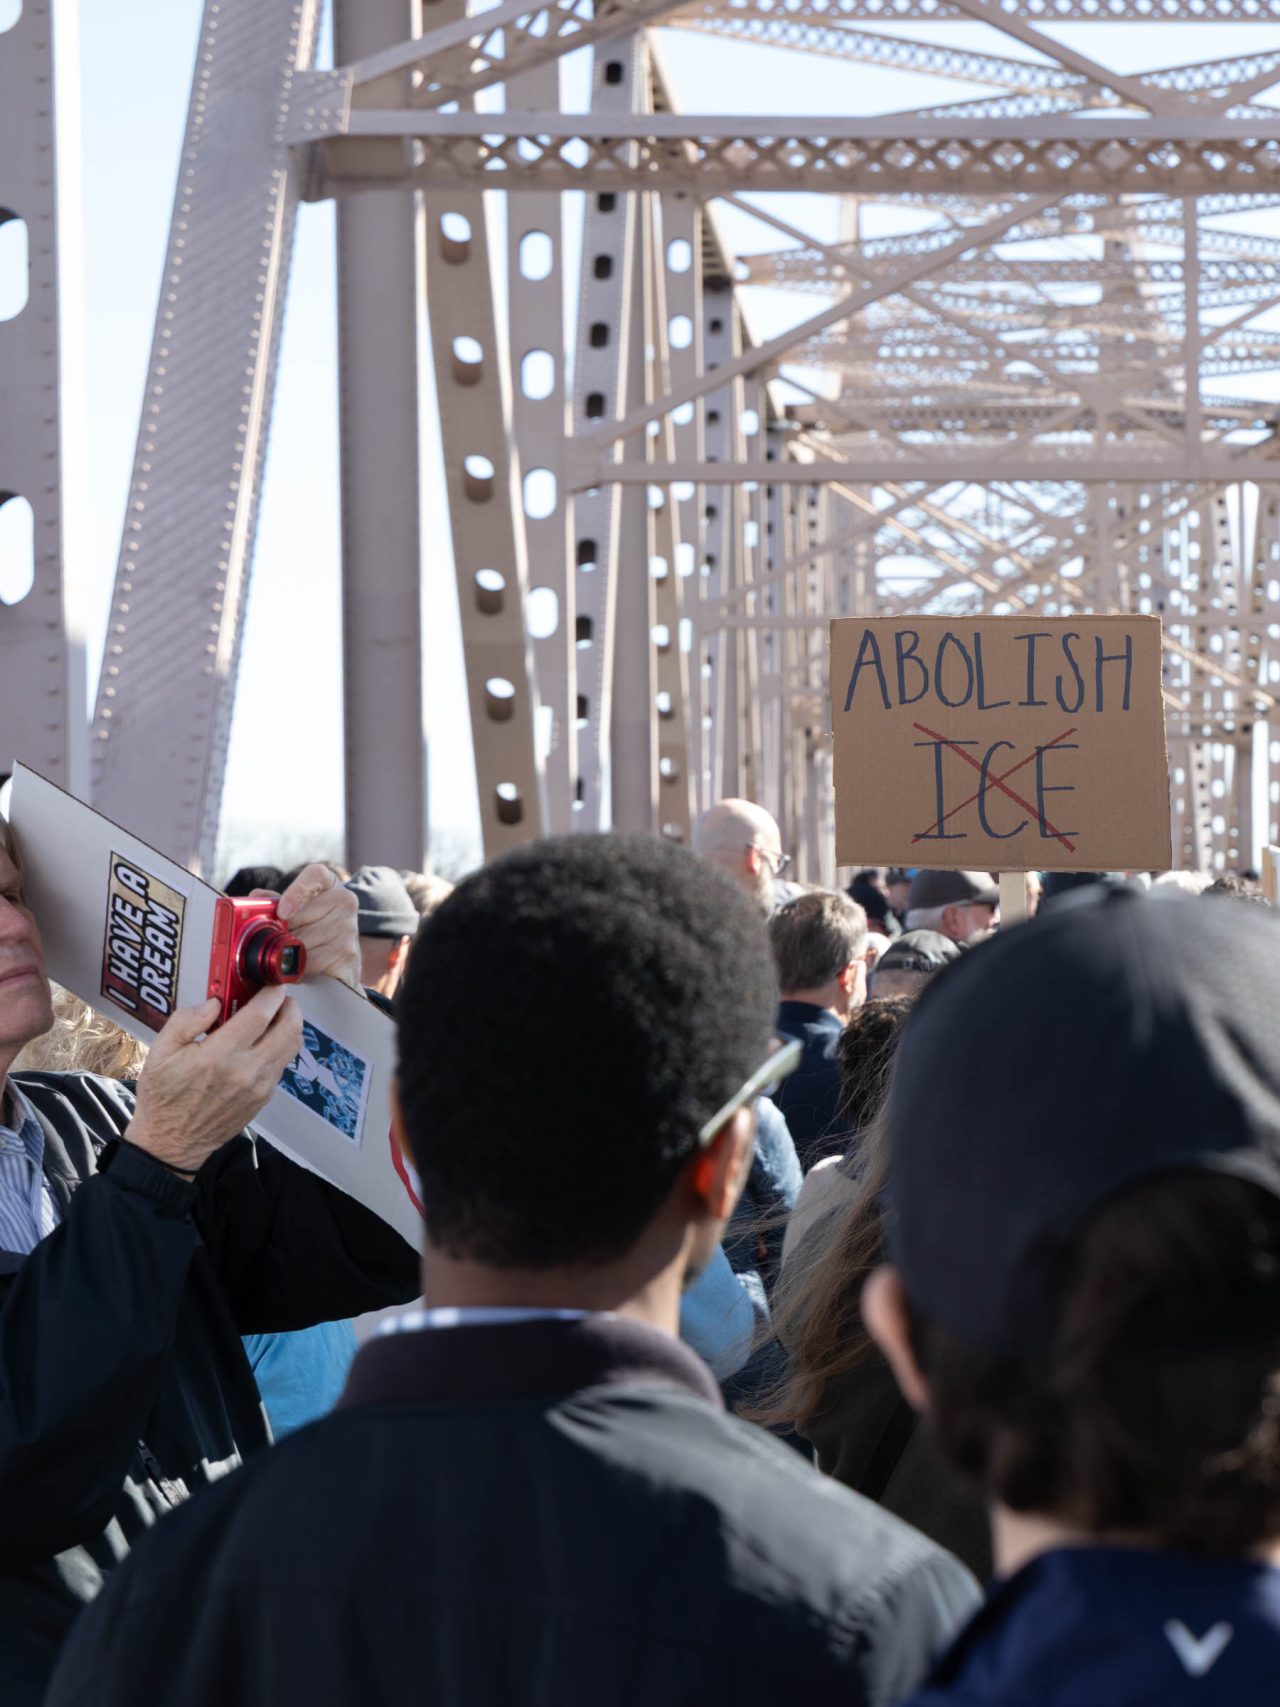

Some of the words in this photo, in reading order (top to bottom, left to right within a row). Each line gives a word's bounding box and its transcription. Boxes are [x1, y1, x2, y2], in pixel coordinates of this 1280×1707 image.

[844, 629, 1132, 713] ABOLISH
[913, 740, 1079, 839] ICE
[114, 863, 149, 899] A
[108, 895, 145, 988] HAVE
[139, 899, 179, 1015] DREAM
[107, 986, 139, 1012] I
